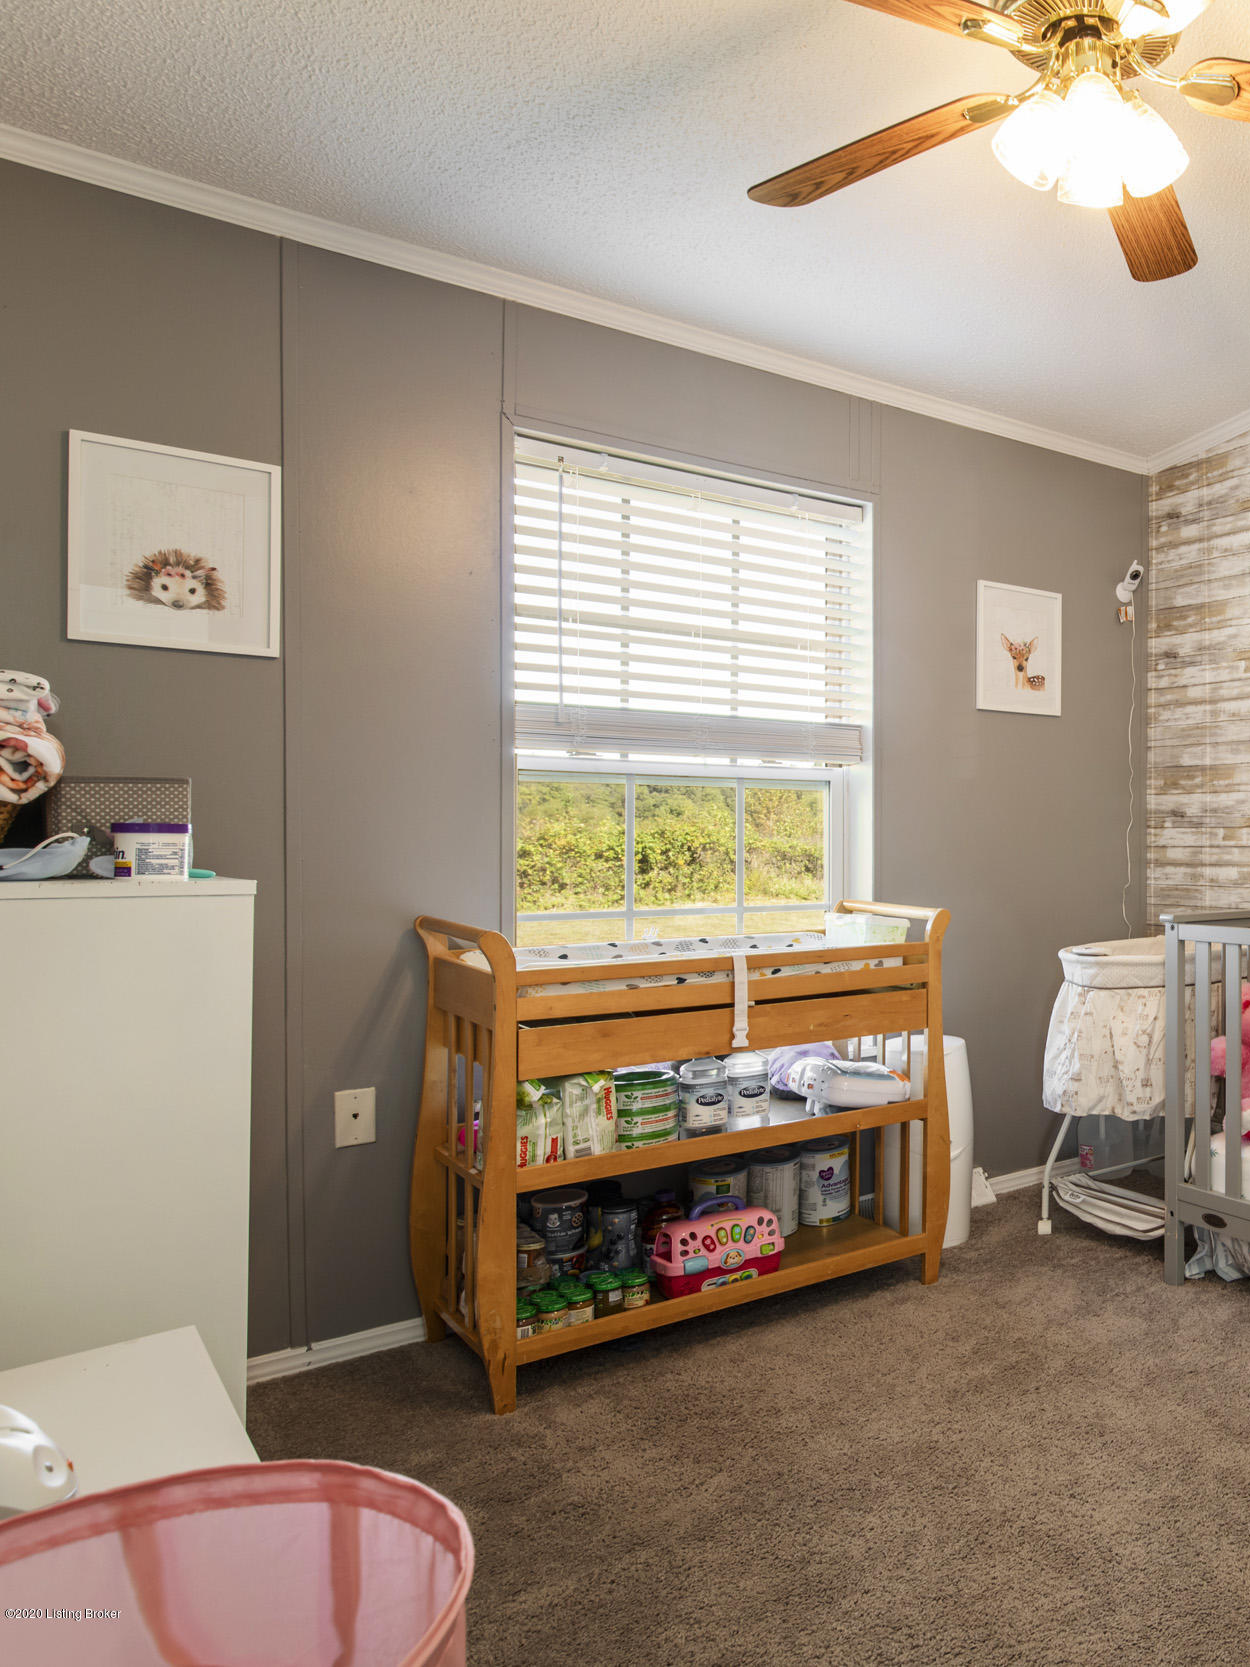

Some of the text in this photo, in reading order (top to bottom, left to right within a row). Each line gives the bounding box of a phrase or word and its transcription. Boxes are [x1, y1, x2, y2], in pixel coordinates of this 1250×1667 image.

[740, 1086, 766, 1097] Pedialyte
[603, 1086, 613, 1121] HUGGIES
[697, 1094, 724, 1104] Pedialyte
